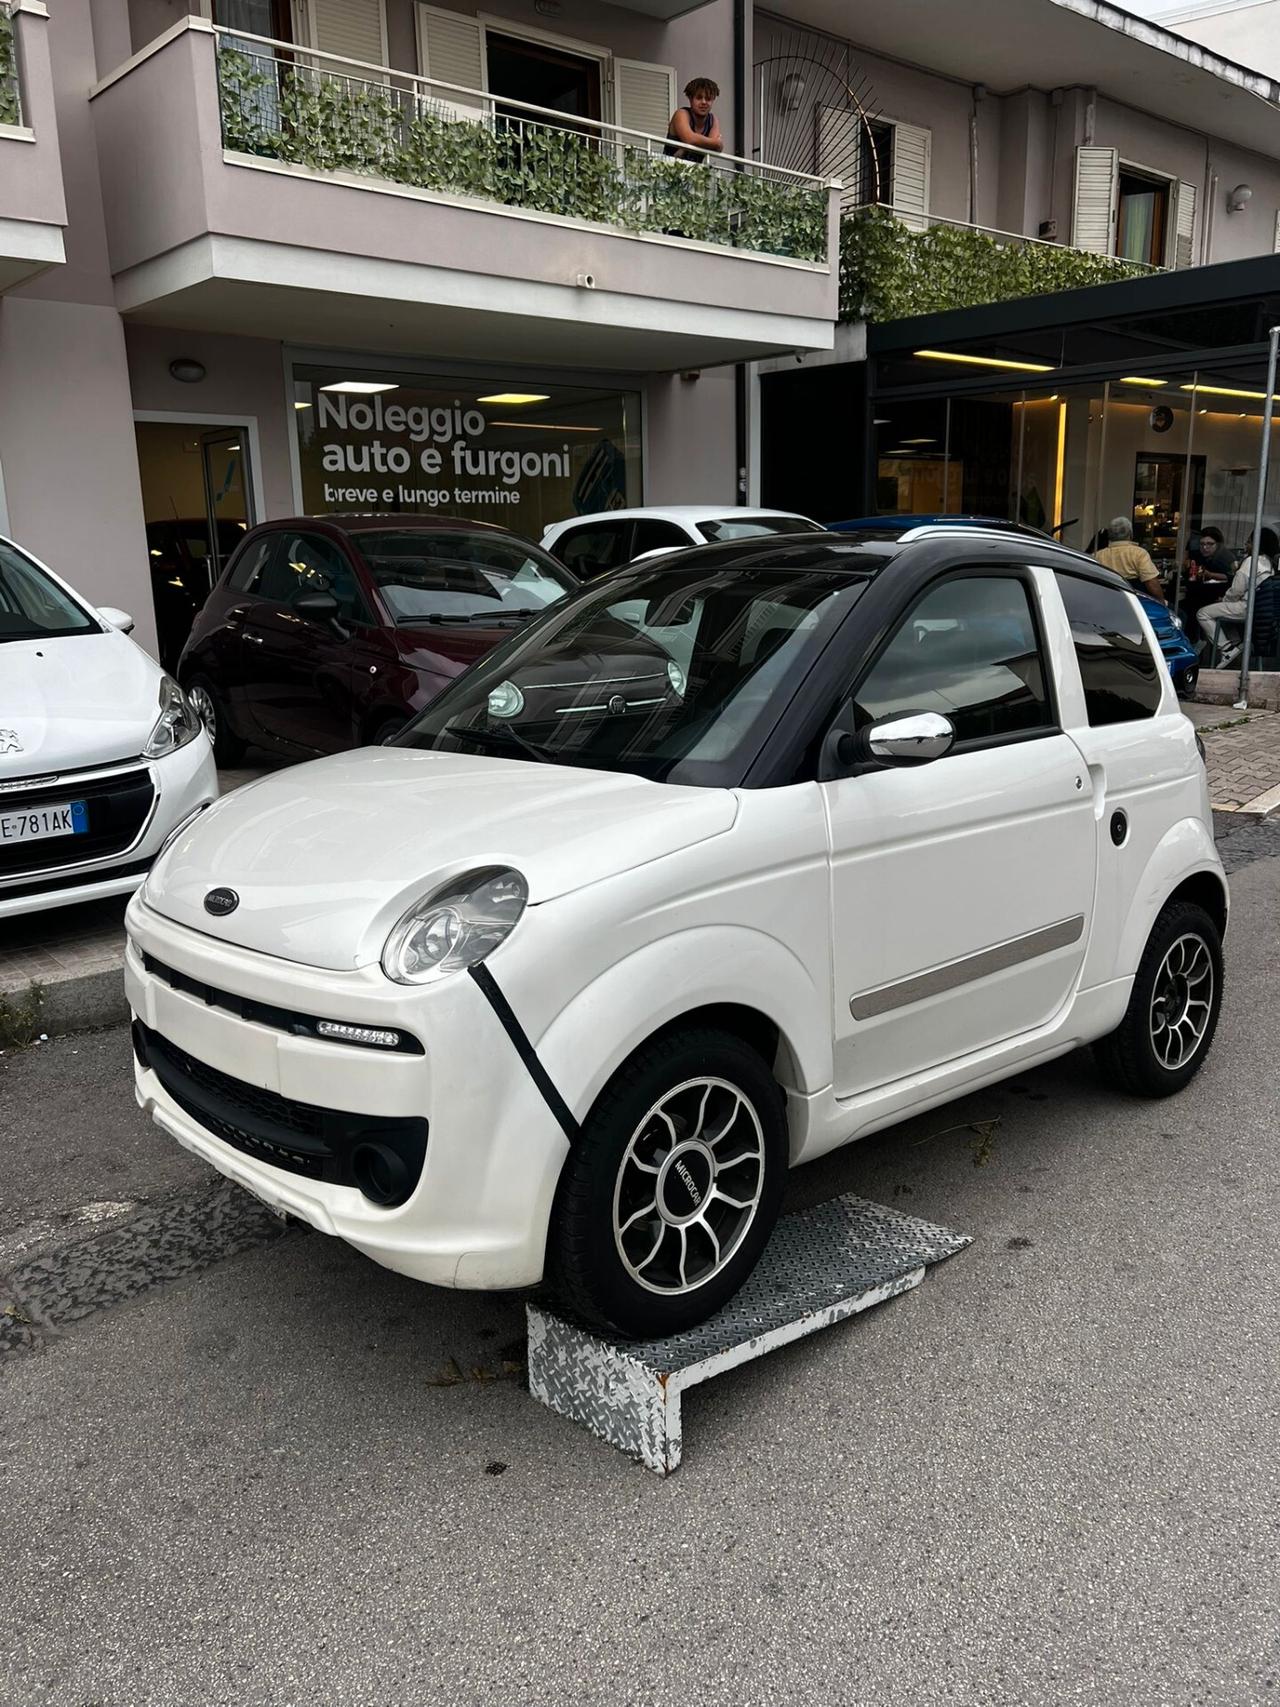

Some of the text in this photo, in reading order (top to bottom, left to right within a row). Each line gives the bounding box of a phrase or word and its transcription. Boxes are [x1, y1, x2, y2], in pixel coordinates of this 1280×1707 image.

[318, 394, 485, 442] Noleggio
[322, 440, 570, 484] auto e furgoni
[324, 483, 520, 507] breve e lungo termine
[675, 1160, 702, 1206] MICROCAR
